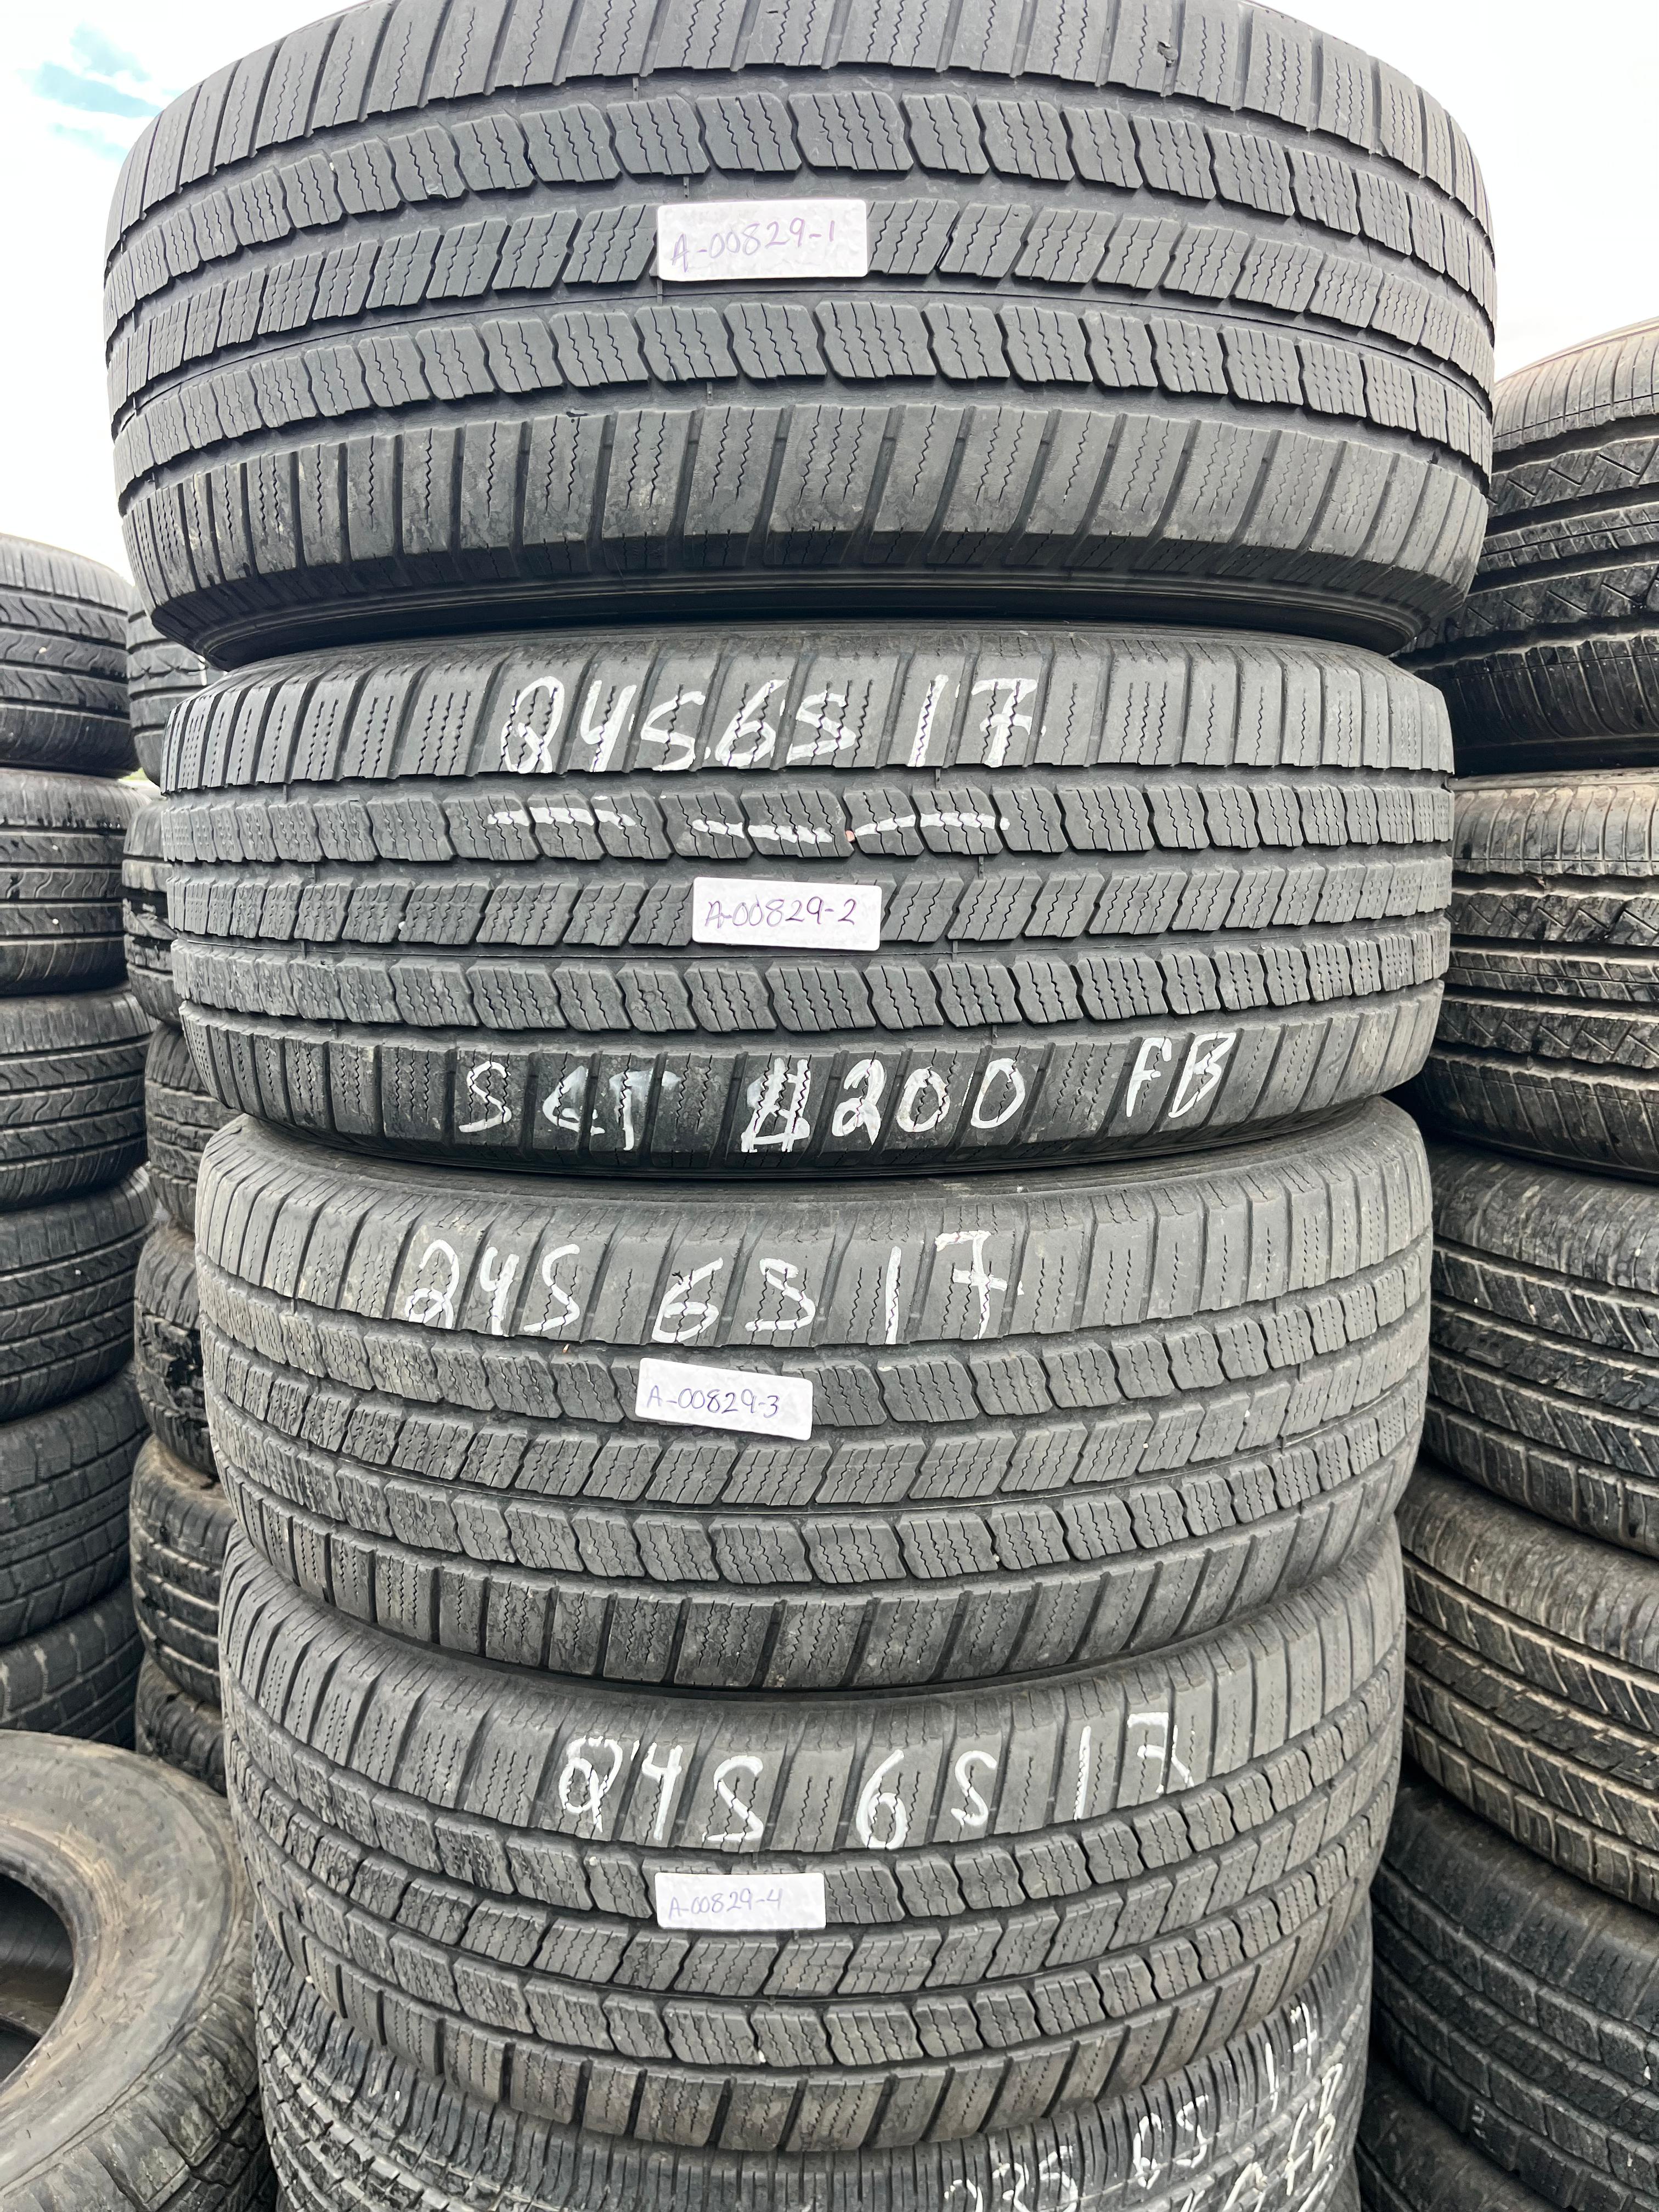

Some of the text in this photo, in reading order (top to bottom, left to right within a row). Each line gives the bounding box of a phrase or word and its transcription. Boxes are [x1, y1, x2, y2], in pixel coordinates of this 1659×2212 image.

[671, 217, 835, 272] A-00829-1
[907, 674, 1038, 768] 17
[704, 894, 857, 929] A-00829-2
[1126, 1032, 1237, 1118] FB
[405, 1229, 1024, 1344] 245 65 17
[647, 1385, 780, 1419] A-00829-3
[558, 1712, 1194, 1850] 245 65 17
[669, 1888, 783, 1920] A-00829-4
